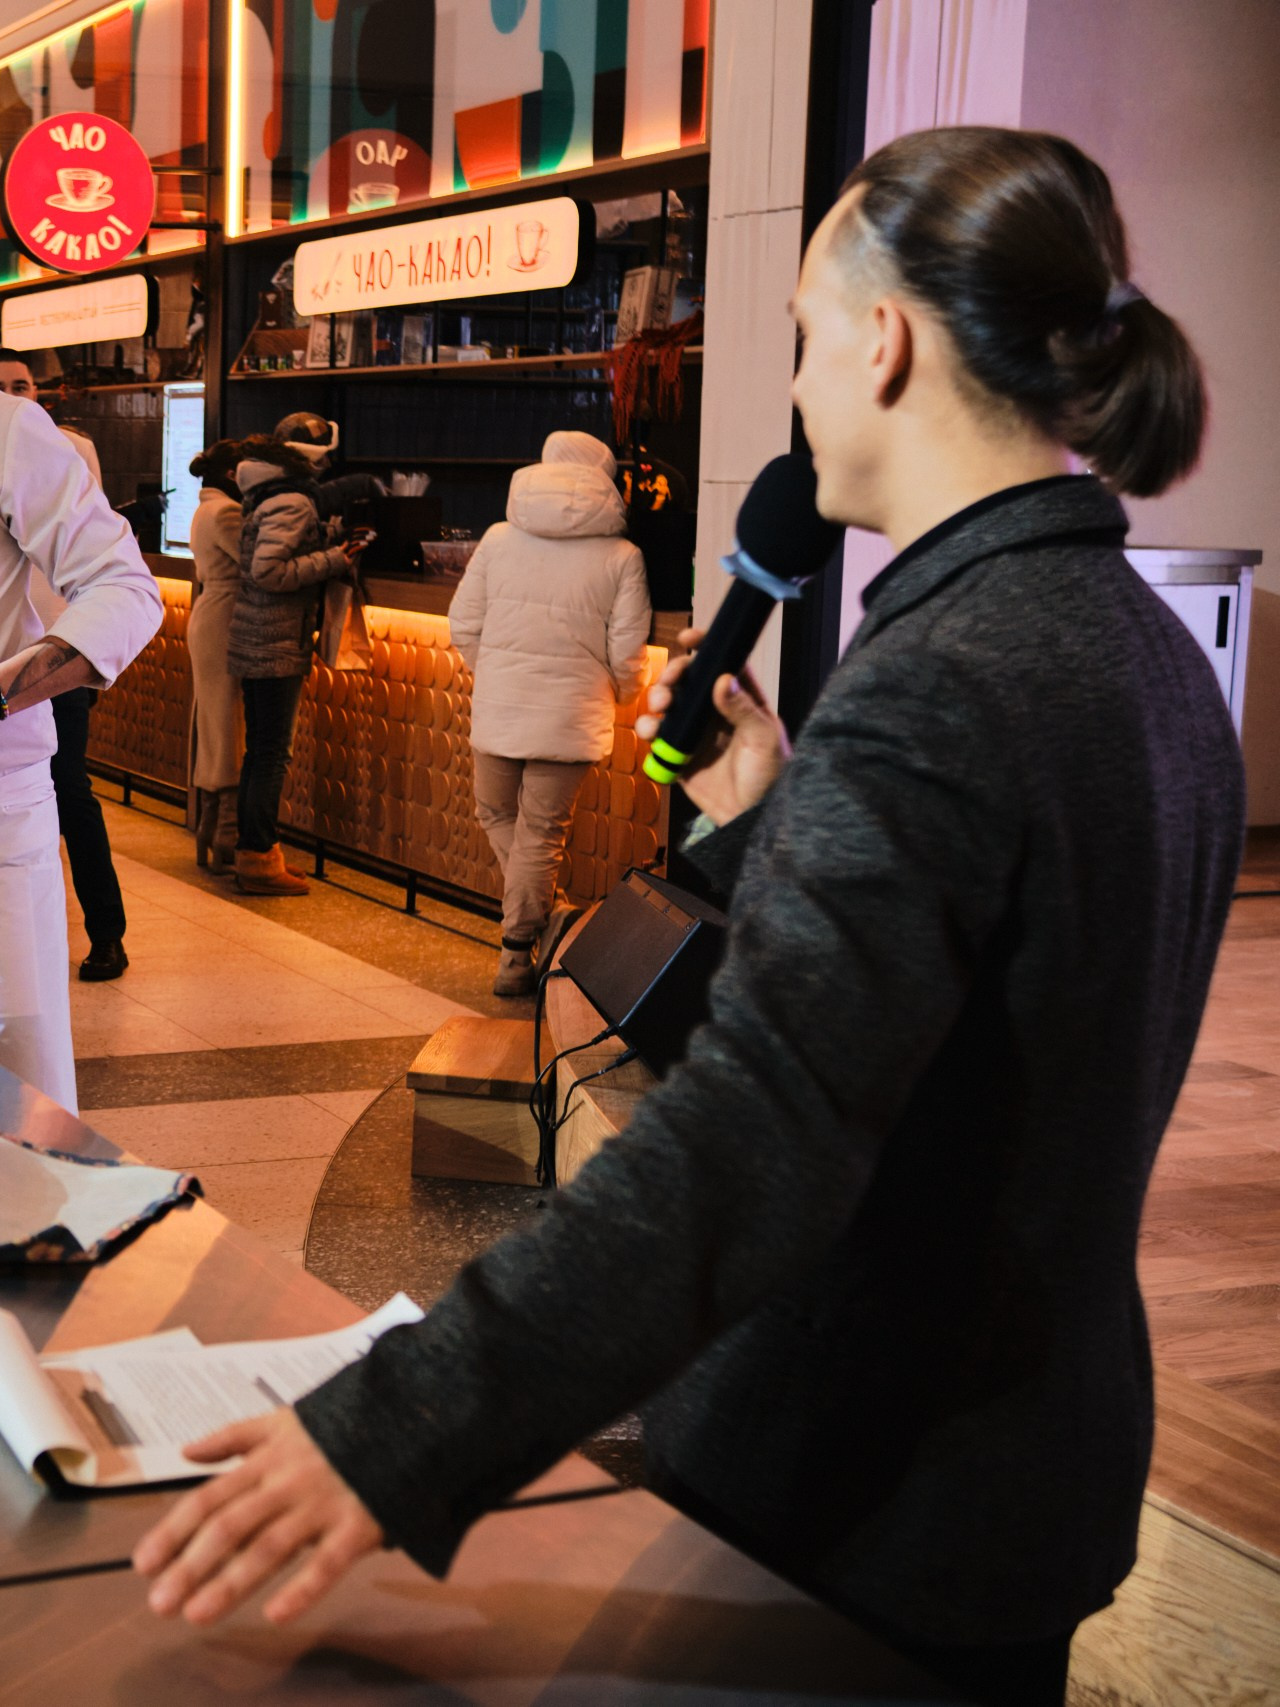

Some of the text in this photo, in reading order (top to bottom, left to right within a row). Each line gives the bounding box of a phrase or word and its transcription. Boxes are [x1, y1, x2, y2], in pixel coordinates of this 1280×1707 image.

[49, 123, 107, 152] ЧАО
[30, 214, 133, 261] КАКАО!
[352, 224, 492, 295] ЧАО-КАКАО!
